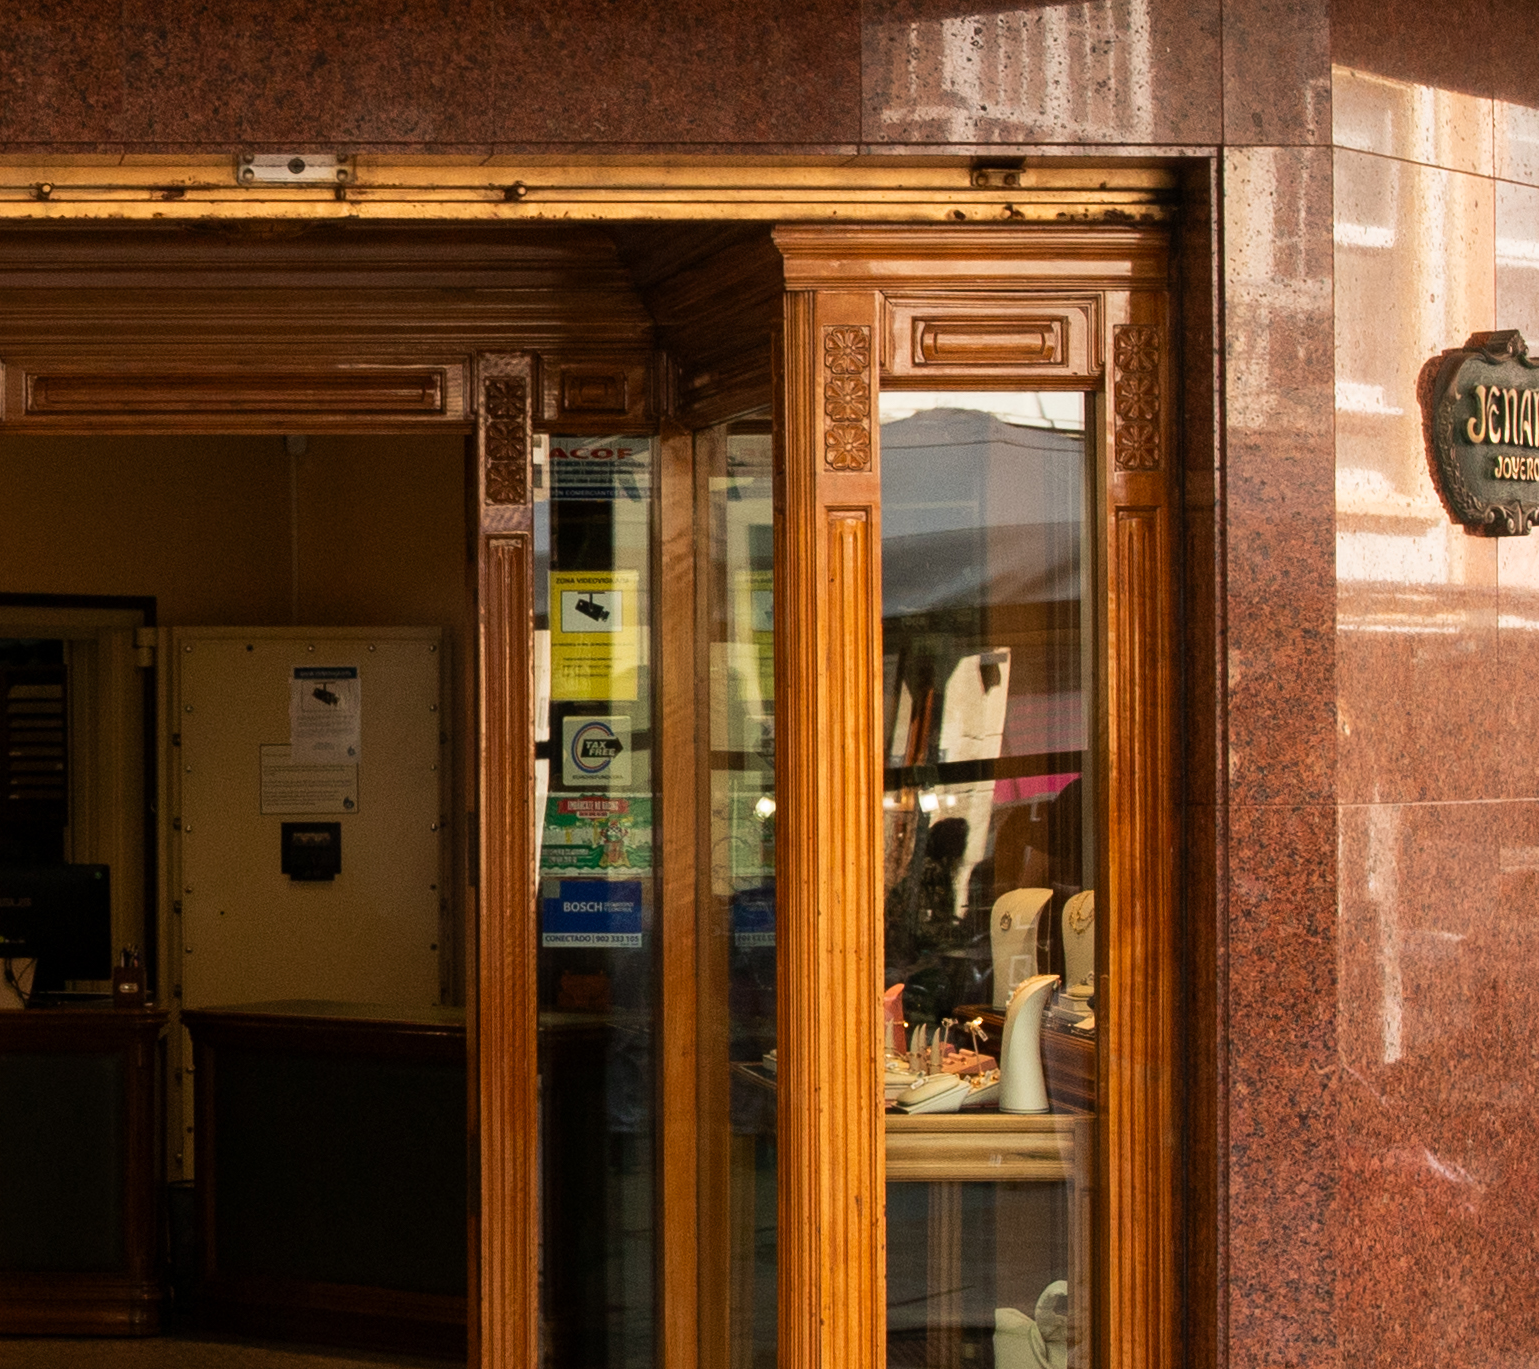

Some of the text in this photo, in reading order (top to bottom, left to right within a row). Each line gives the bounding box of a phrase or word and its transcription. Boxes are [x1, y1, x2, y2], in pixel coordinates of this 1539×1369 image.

[585, 741, 607, 749] TAX
[589, 748, 616, 757] FREE
[563, 902, 603, 913] BOSCH
[545, 934, 591, 943] CONECTADO
[595, 934, 610, 943] 902
[611, 934, 625, 943] 333
